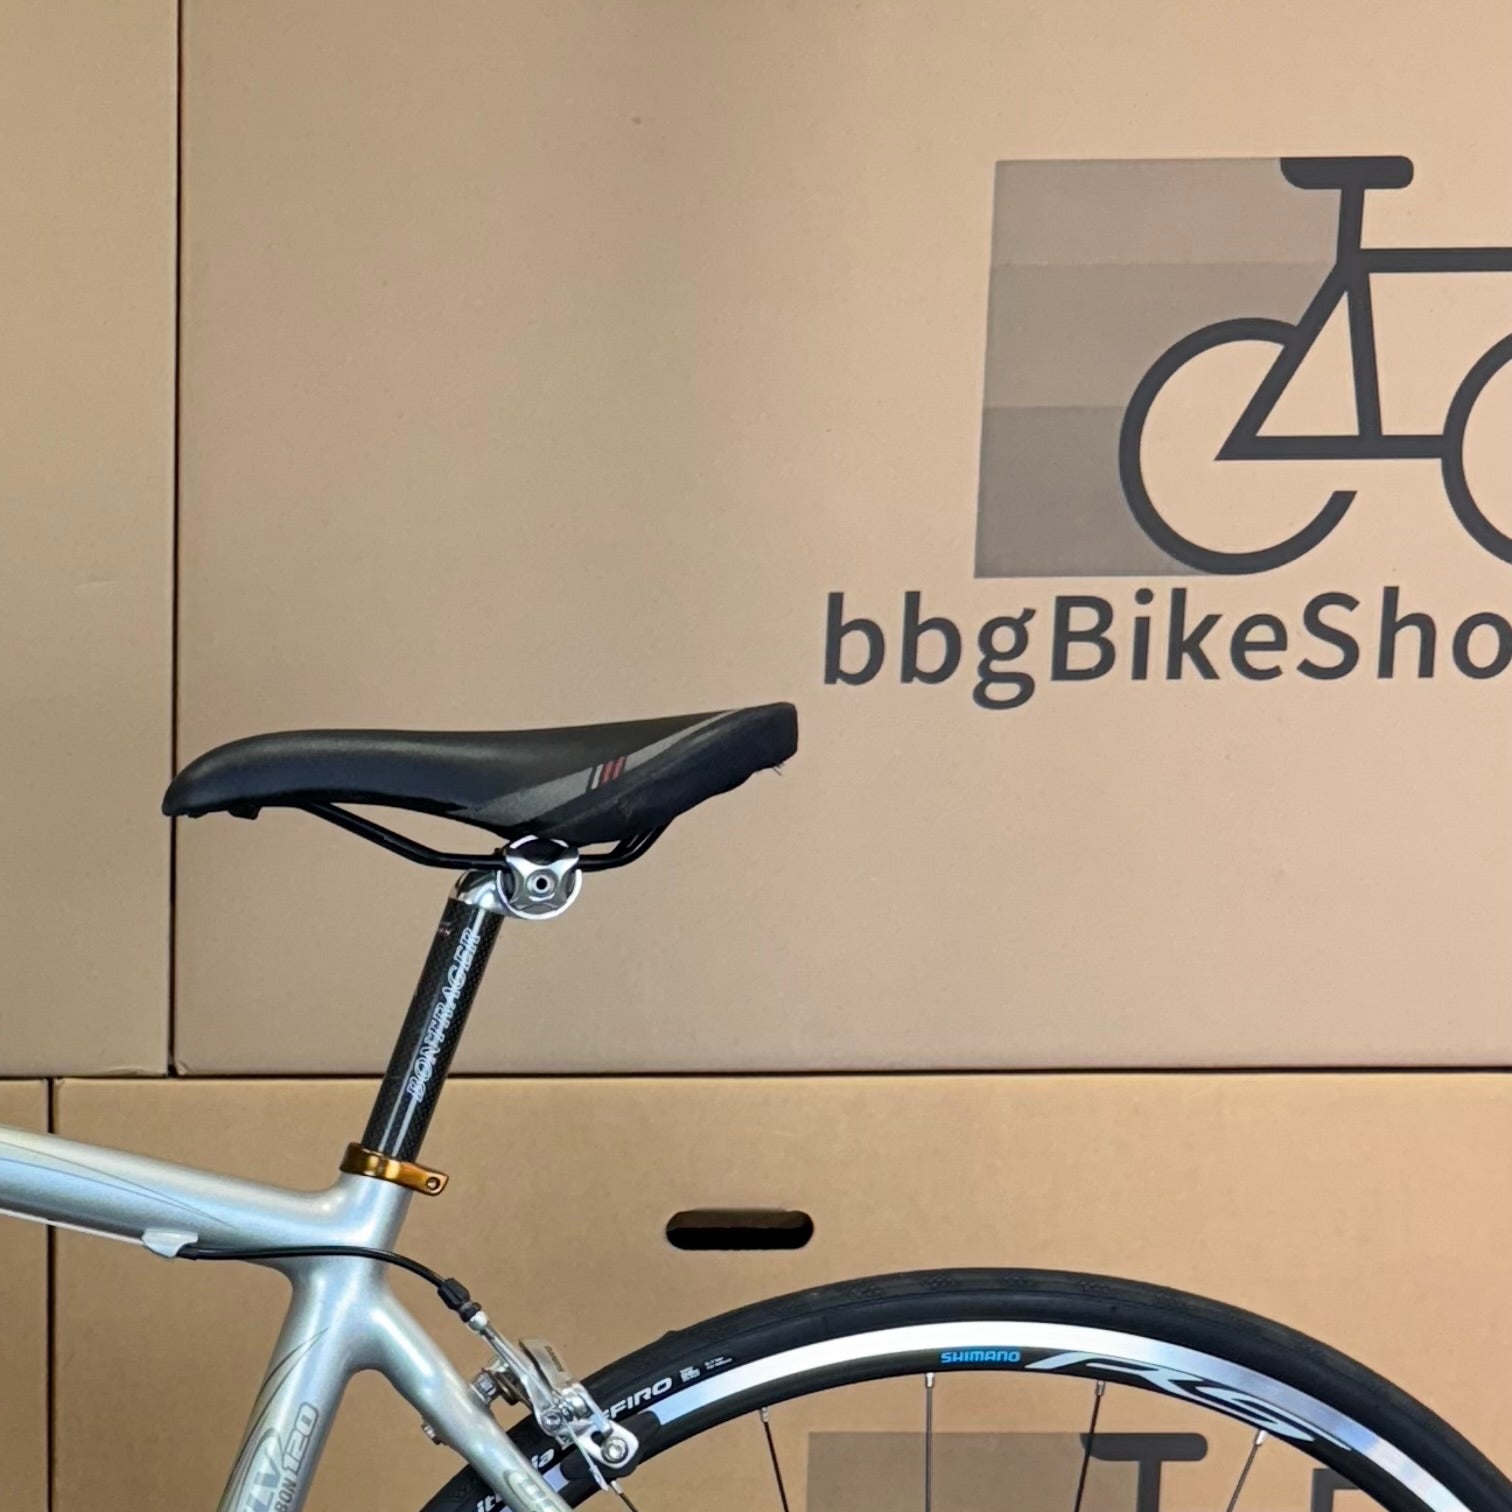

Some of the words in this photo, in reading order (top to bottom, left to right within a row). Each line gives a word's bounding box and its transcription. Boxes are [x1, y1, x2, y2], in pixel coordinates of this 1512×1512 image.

[824, 586, 1512, 711] bbgBikeSho
[407, 927, 480, 1103] BONTRAGER
[940, 1350, 1021, 1364] SHIMANO
[281, 1402, 319, 1476] 120
